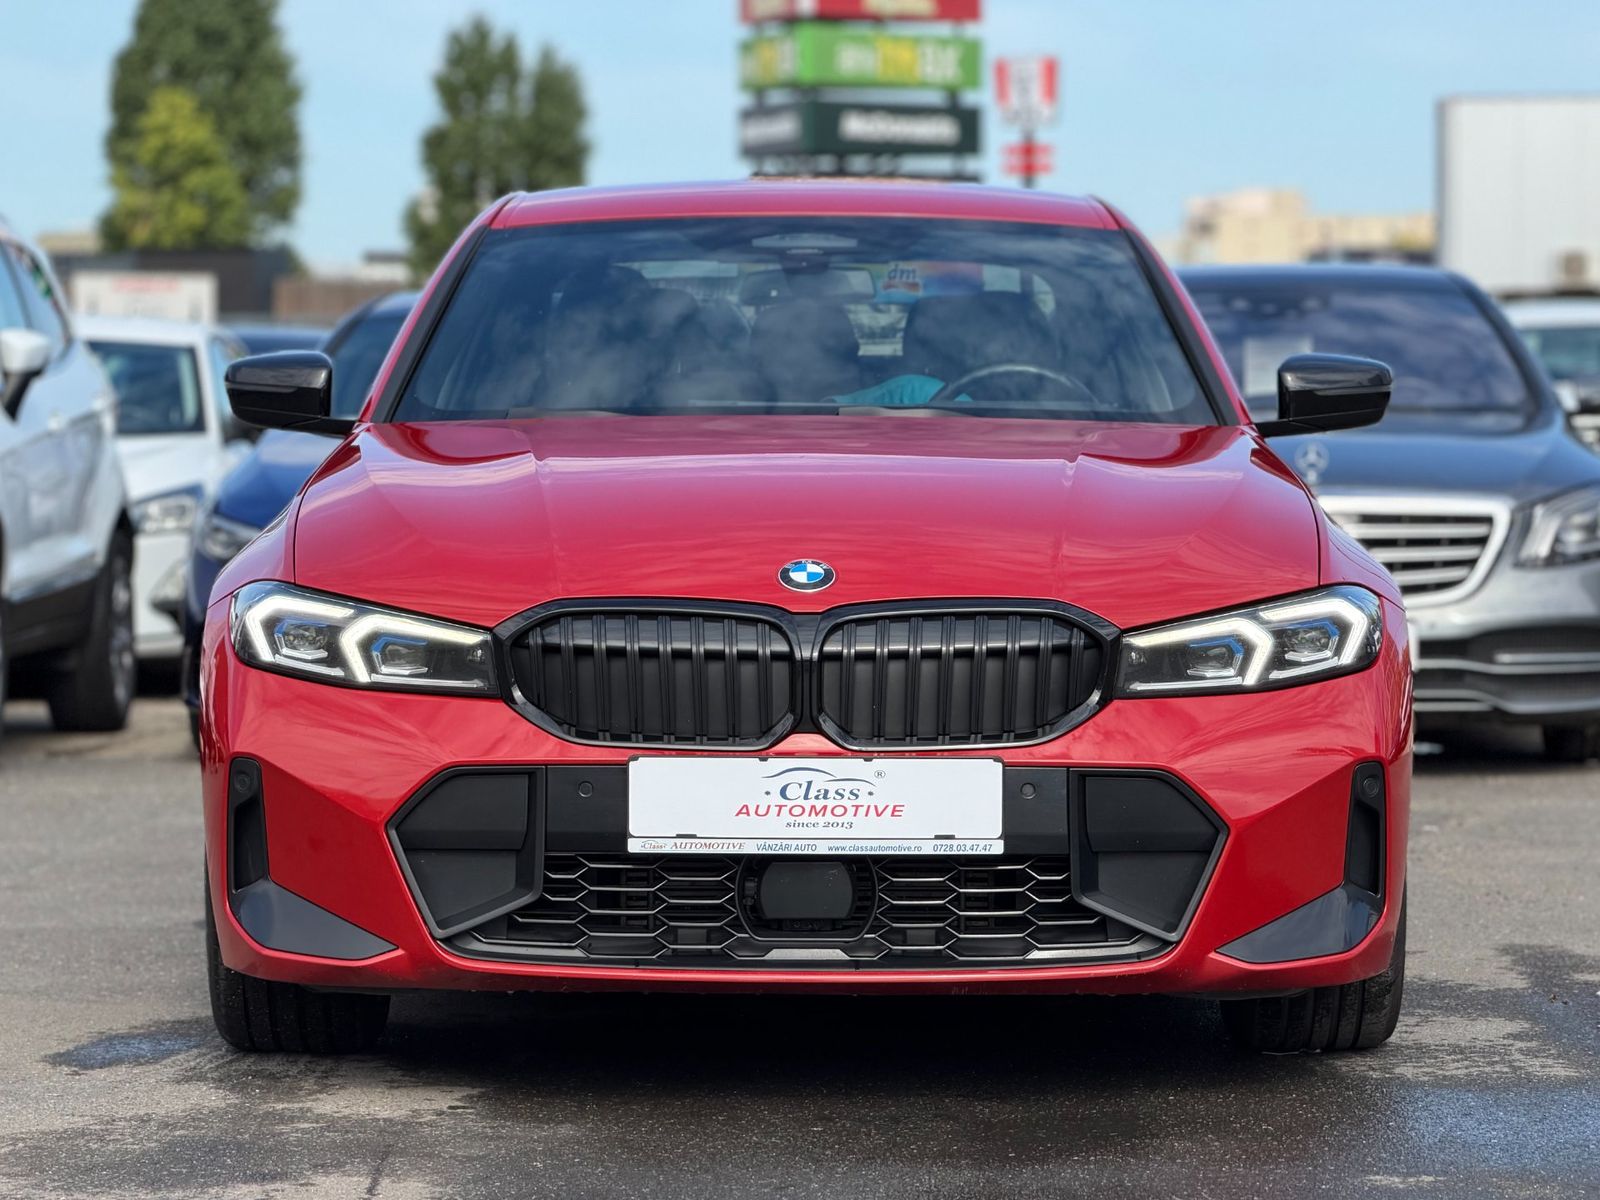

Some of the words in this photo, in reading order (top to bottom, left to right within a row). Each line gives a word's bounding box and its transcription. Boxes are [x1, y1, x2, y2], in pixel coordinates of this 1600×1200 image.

[779, 780, 861, 801] Class
[734, 804, 905, 818] AUTOMOTIVE
[785, 819, 819, 829] since
[822, 821, 854, 830] 2013
[670, 841, 746, 850] AUTOMOTIVE
[793, 843, 817, 852] AUTO
[827, 843, 922, 852] www.classautomotive.ro
[932, 843, 992, 853] 0728.03.47.47
